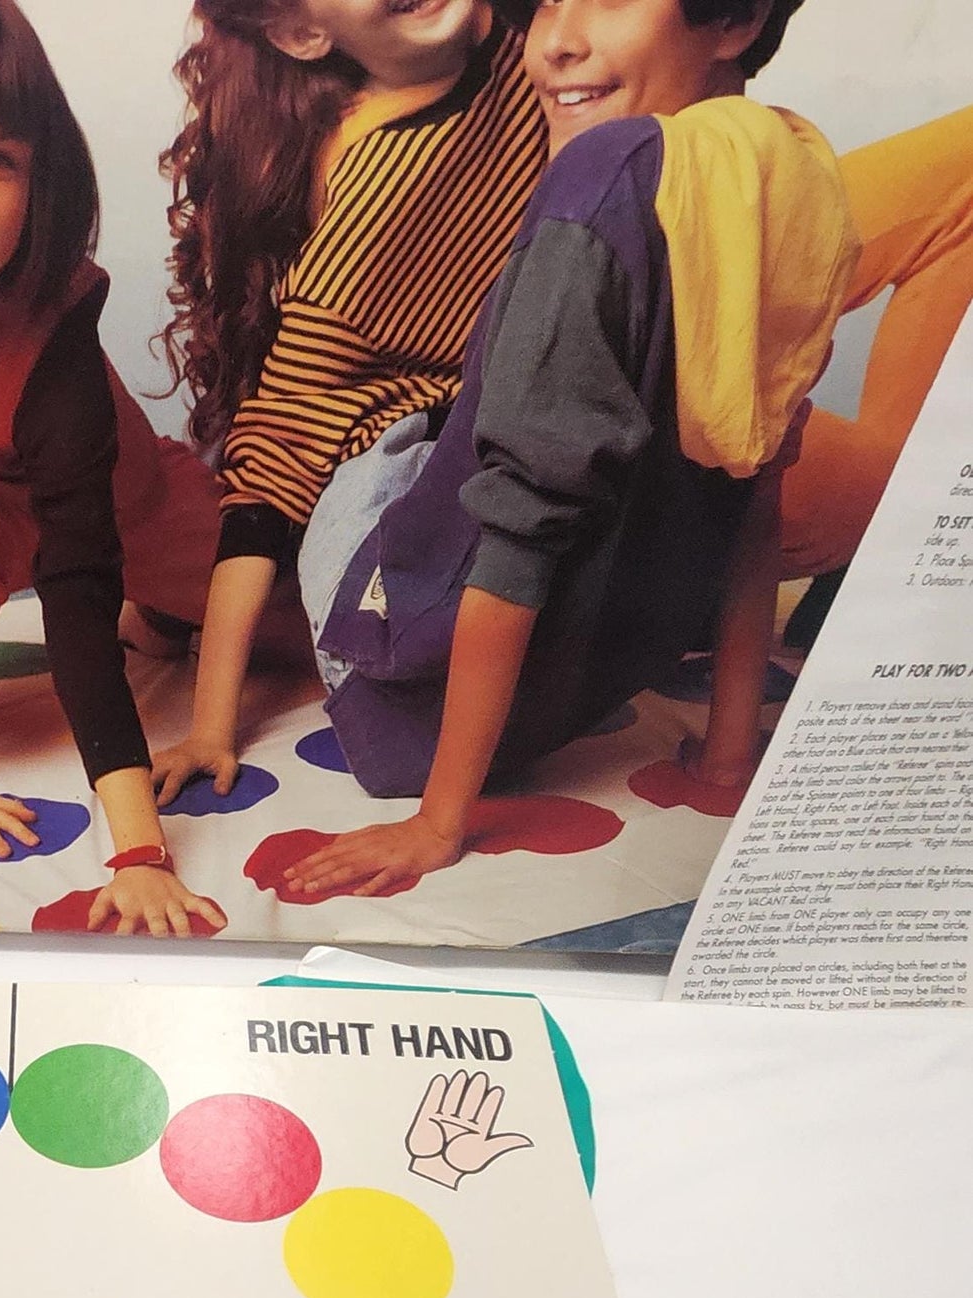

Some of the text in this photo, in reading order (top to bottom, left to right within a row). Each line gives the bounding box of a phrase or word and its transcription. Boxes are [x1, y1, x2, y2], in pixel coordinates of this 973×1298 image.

[933, 515, 973, 529] TO SET
[924, 533, 944, 546] side
[930, 553, 956, 567] Place
[871, 663, 967, 678] PLAY FOR TWO
[712, 901, 724, 909] on
[726, 900, 744, 910] any
[747, 896, 788, 907] VACANT
[789, 895, 808, 905] Red
[721, 912, 746, 923] ONE
[748, 911, 767, 921] limb
[769, 910, 790, 920] from
[793, 909, 817, 920] ONE
[819, 908, 849, 920] player
[853, 907, 872, 920] only
[876, 910, 893, 918] can
[896, 909, 928, 920] occupy
[932, 909, 950, 919] any
[953, 909, 972, 917] one
[701, 926, 724, 936] circle
[726, 926, 737, 935] at
[737, 923, 762, 935] ONE
[785, 922, 794, 932] If
[794, 922, 816, 932] both
[816, 921, 850, 934] players
[853, 920, 877, 930] reach
[880, 919, 893, 930] for
[897, 919, 911, 930] the
[915, 922, 939, 930] same
[942, 919, 969, 930] circle,
[696, 939, 709, 949] the
[711, 937, 746, 948] Referee
[746, 935, 780, 946] decides
[782, 934, 807, 945] which
[807, 933, 838, 946] player
[860, 933, 884, 943] there
[885, 932, 904, 943] first
[905, 932, 924, 942] and
[925, 931, 969, 942] therefore
[691, 947, 779, 961] awarded the circle.
[702, 964, 727, 975] Once
[727, 964, 752, 974] limbs
[753, 966, 770, 974] are
[770, 962, 803, 975] placed
[804, 964, 816, 972] on
[818, 961, 849, 973] circles,
[852, 960, 895, 974] including
[897, 960, 919, 970] both
[920, 959, 939, 970] feet
[940, 961, 950, 970] at
[952, 959, 967, 969] the
[683, 971, 968, 989] start, they cannot be moved or lifted without the direction of
[680, 984, 967, 1001] the Referee by each spin. However ONE limb may be lifted to
[828, 1000, 844, 1010] but
[848, 1000, 870, 1009] must
[874, 998, 886, 1009] be
[890, 997, 947, 1008] immediately
[951, 1000, 967, 1008] re-
[246, 1019, 513, 1062] RIGHT HAND
